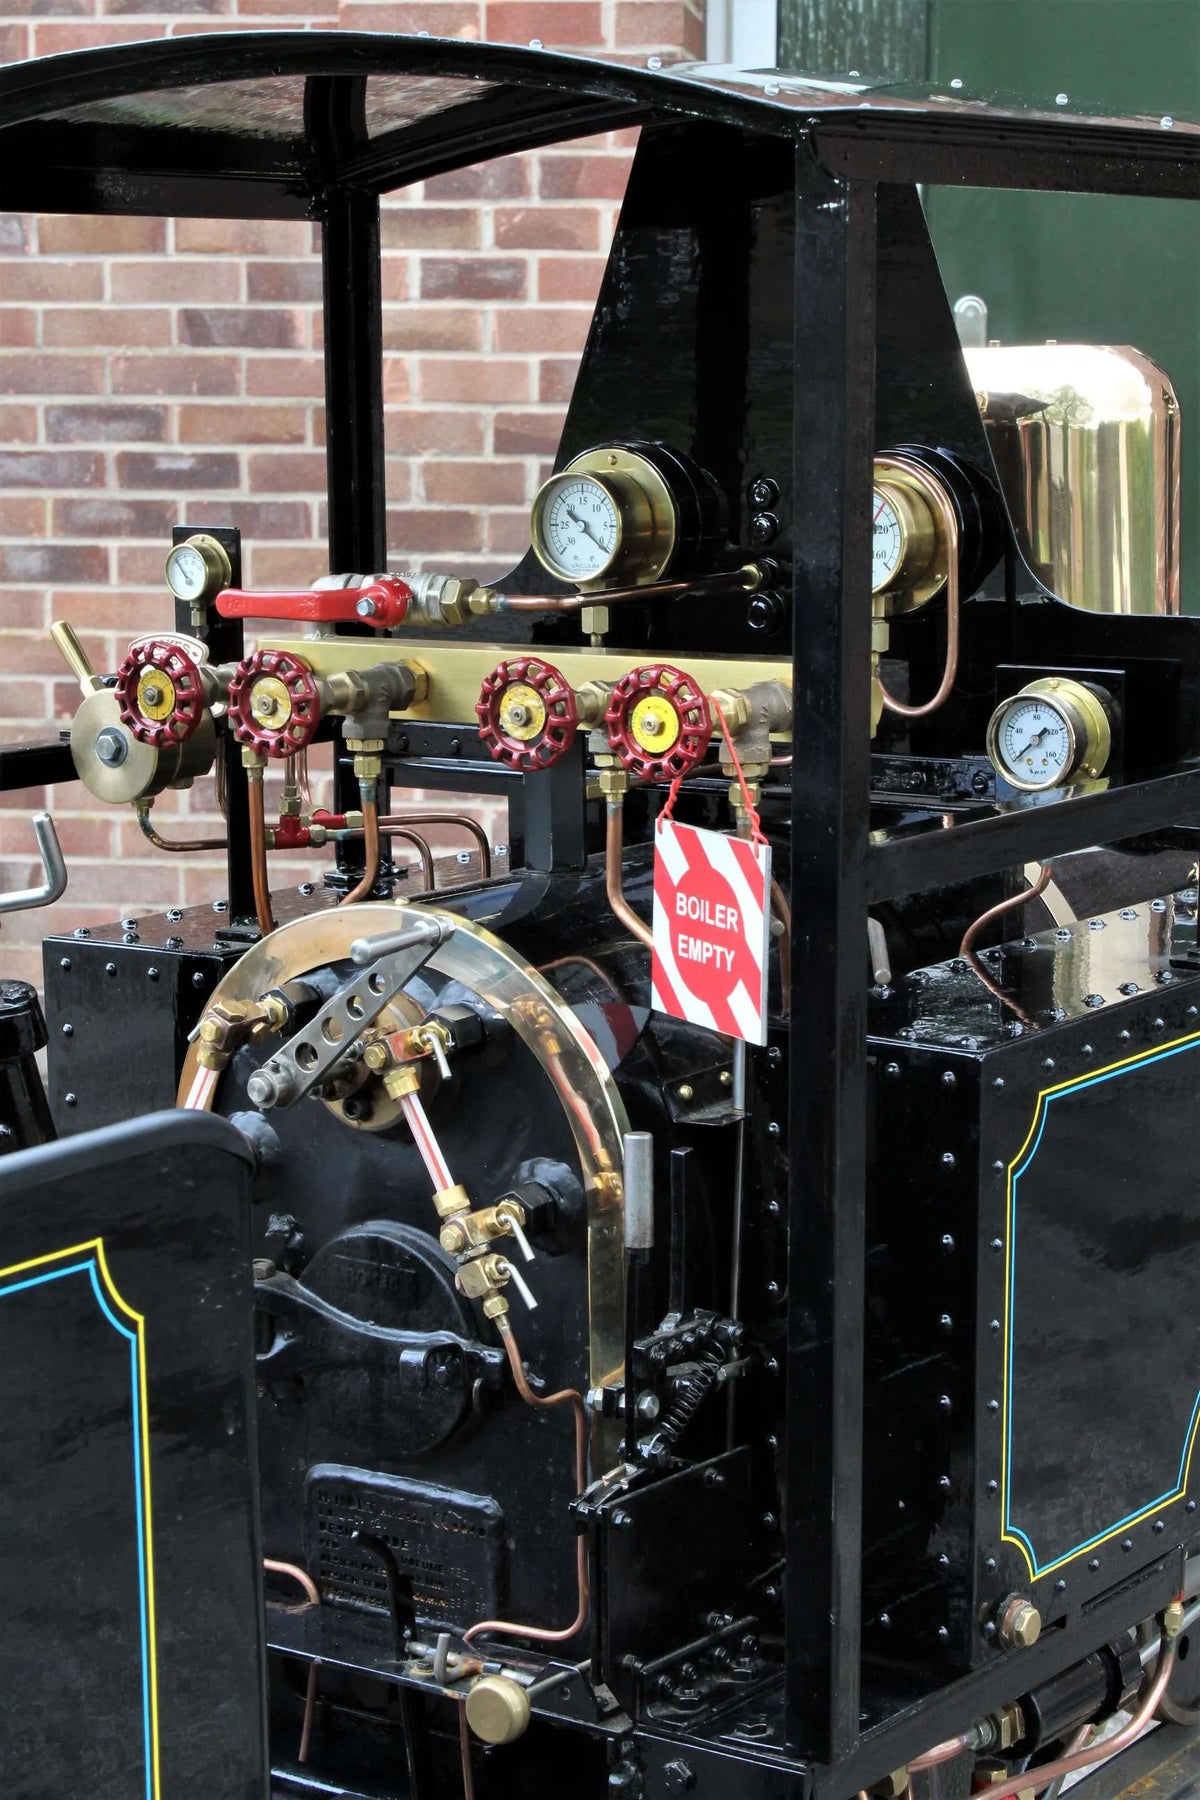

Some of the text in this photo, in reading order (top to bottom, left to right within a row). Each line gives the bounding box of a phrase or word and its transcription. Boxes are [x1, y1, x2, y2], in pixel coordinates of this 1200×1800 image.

[579, 496, 588, 505] 15
[566, 503, 575, 512] 20
[592, 504, 601, 512] 10
[560, 521, 569, 529] 25
[603, 521, 608, 530] 5
[566, 537, 575, 545] 30
[599, 536, 604, 545] 0
[676, 892, 738, 932] BOILER
[678, 933, 735, 972] EMPTY
